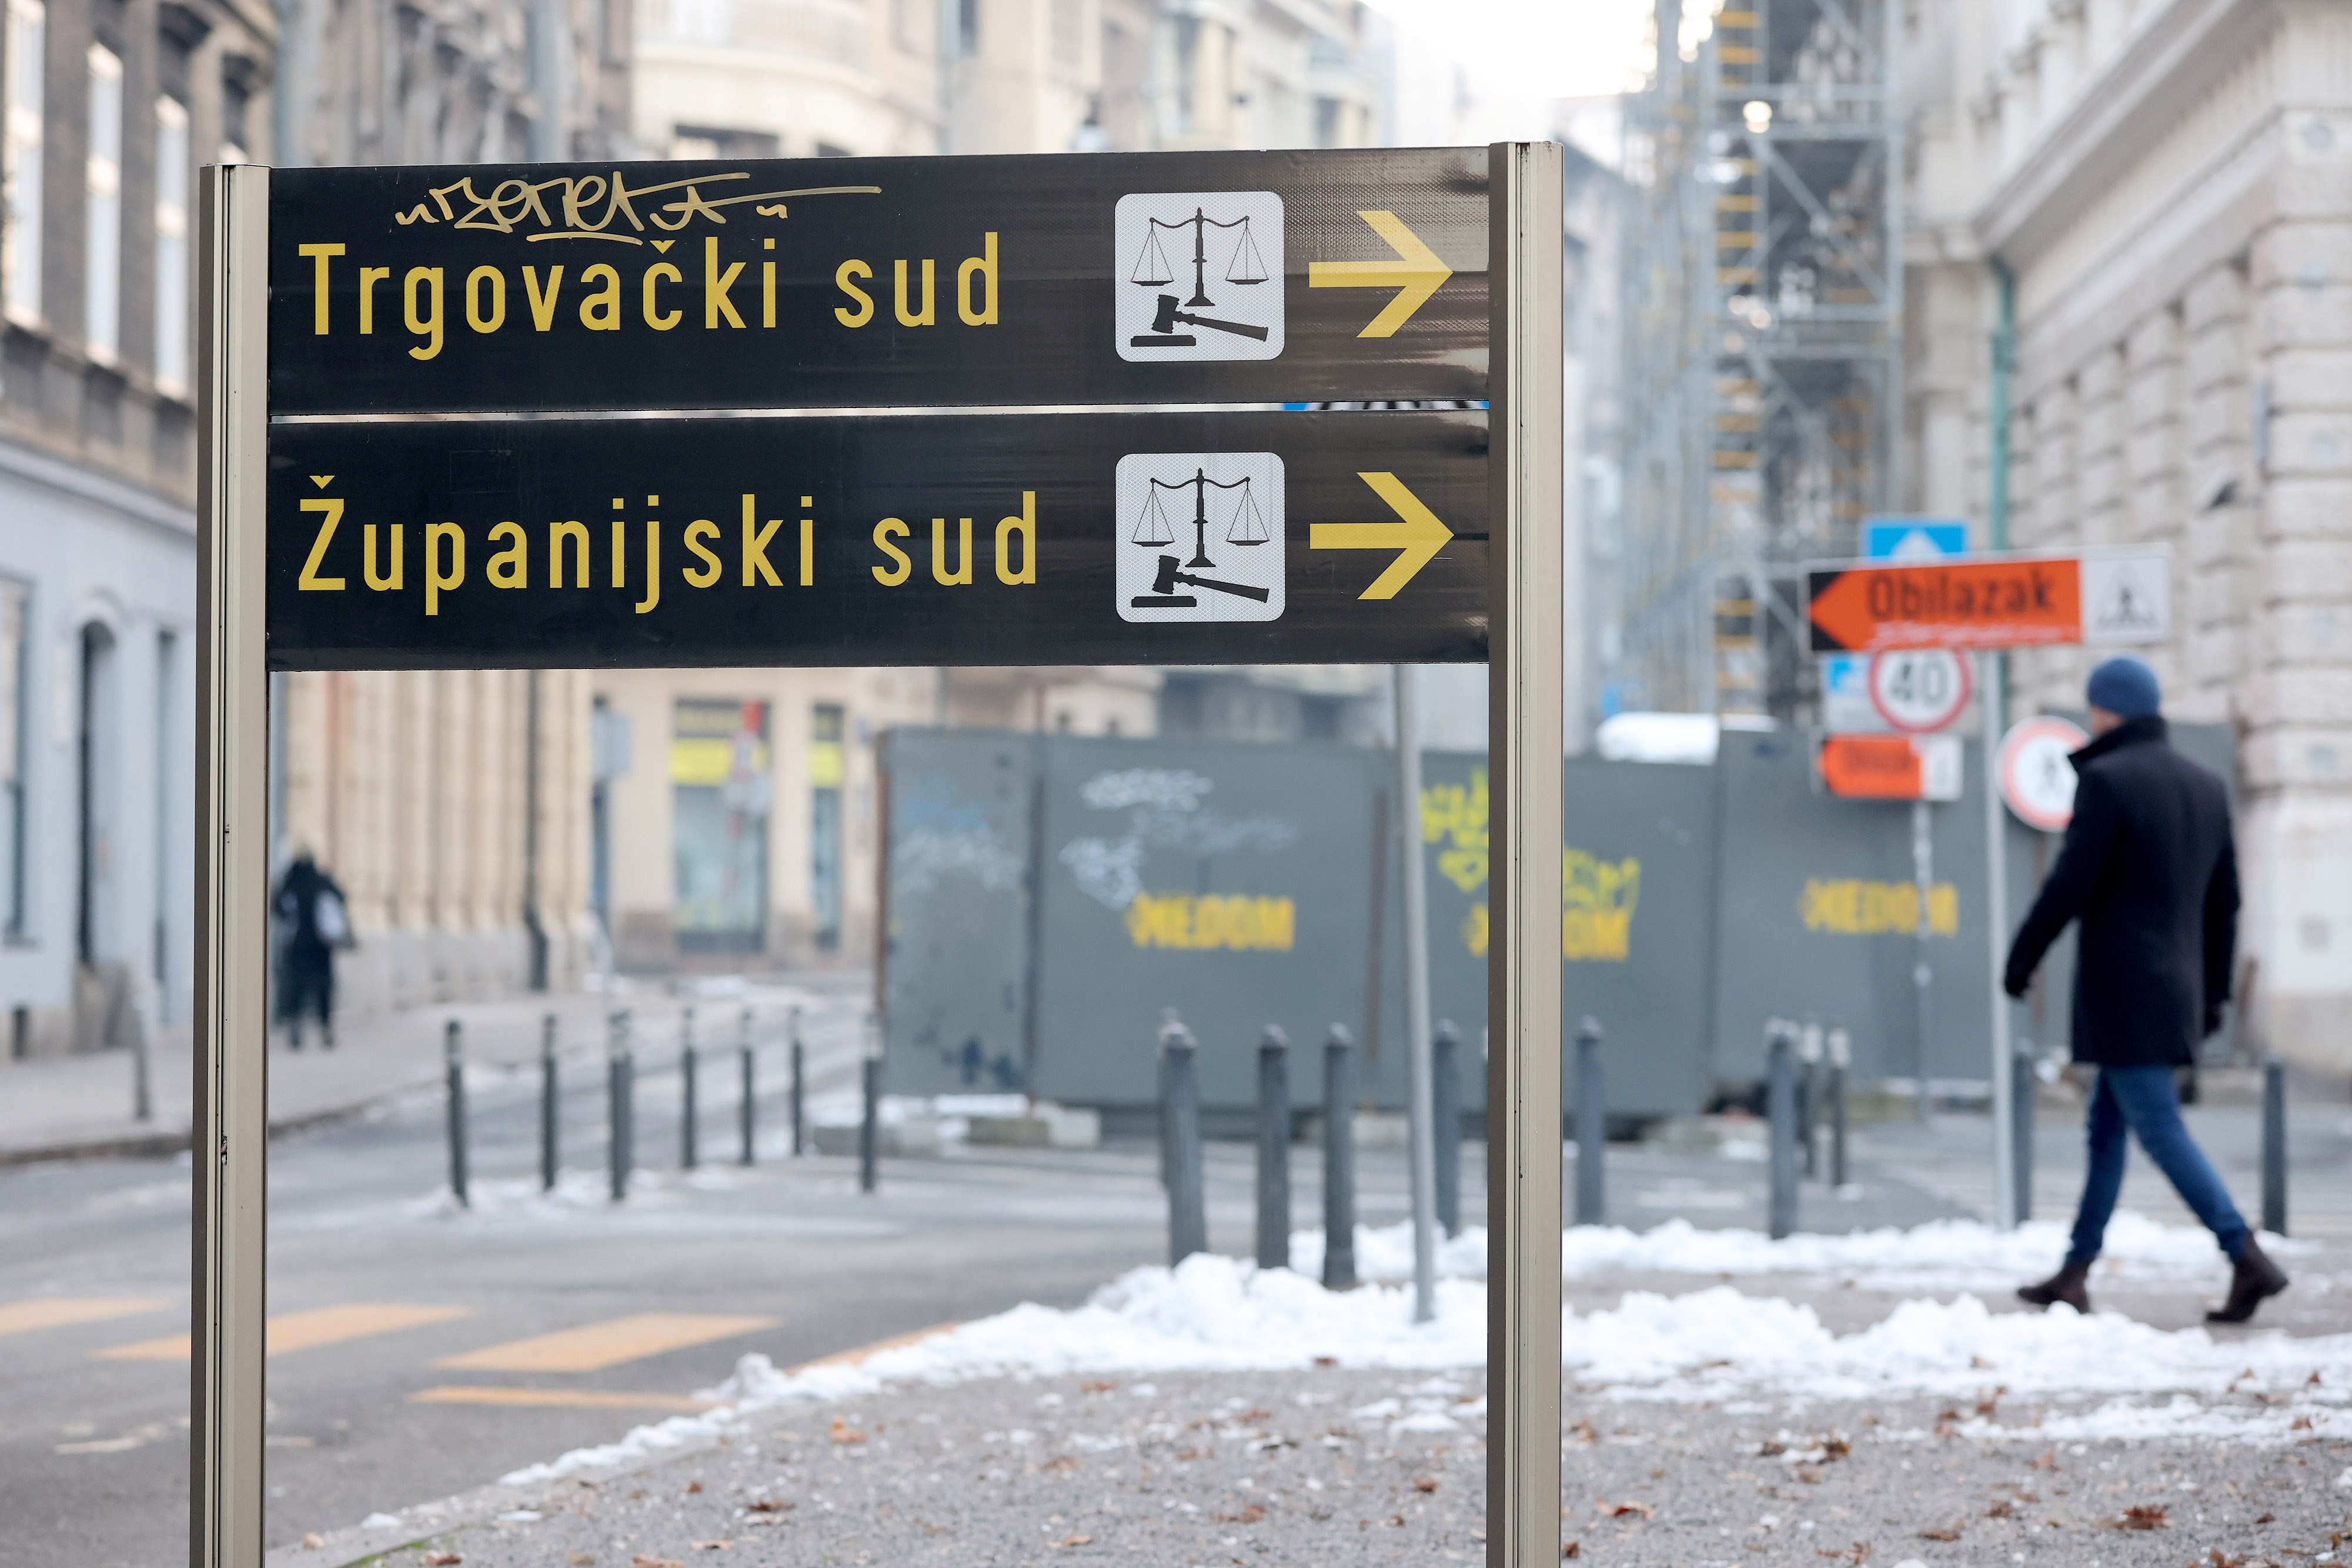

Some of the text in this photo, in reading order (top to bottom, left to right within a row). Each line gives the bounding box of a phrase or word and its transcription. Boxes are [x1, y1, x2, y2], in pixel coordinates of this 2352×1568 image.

[298, 232, 998, 360] Trgovački sud
[298, 475, 1036, 616] Županijski sud
[1867, 566, 2054, 621] Obilazak
[1889, 658, 1949, 707] 40
